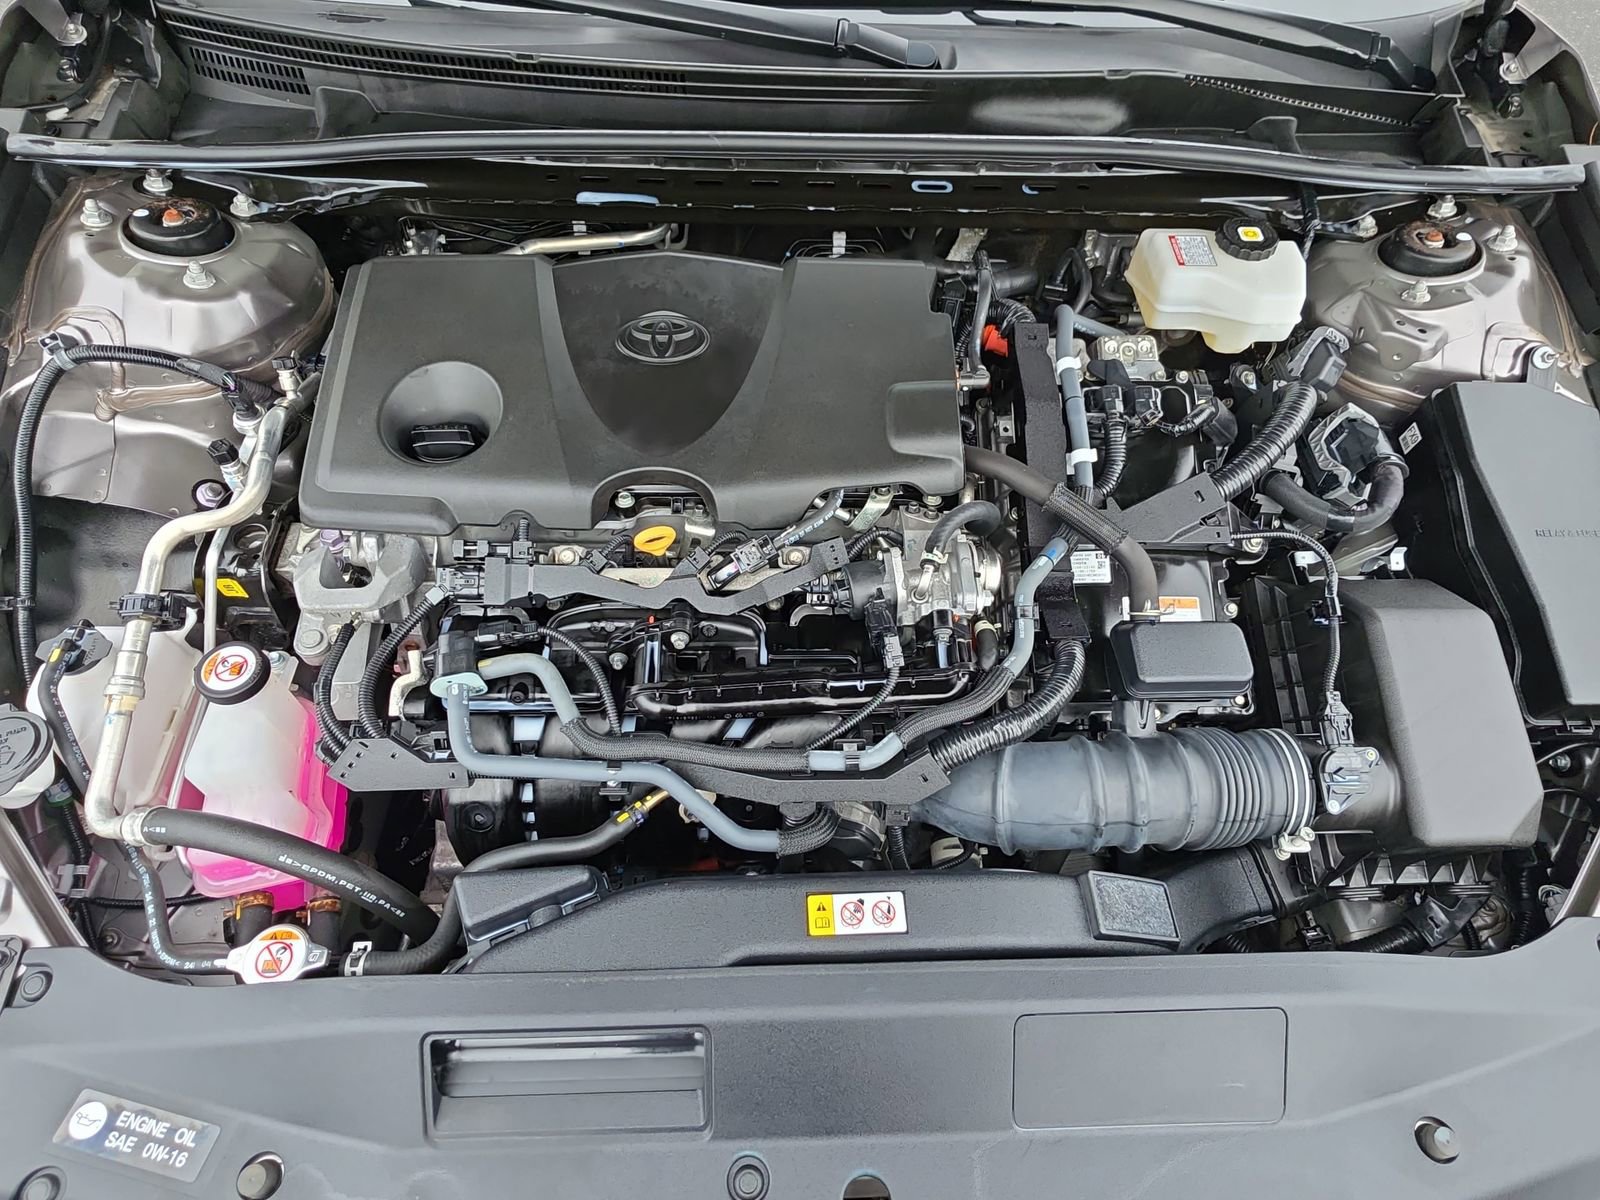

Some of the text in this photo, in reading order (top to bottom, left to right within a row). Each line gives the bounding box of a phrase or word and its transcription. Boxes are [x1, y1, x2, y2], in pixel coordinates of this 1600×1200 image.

[1406, 425, 1420, 445] FX9
[115, 1110, 197, 1148] ENGINE OIL
[104, 1131, 189, 1168] SAE 0W-16
